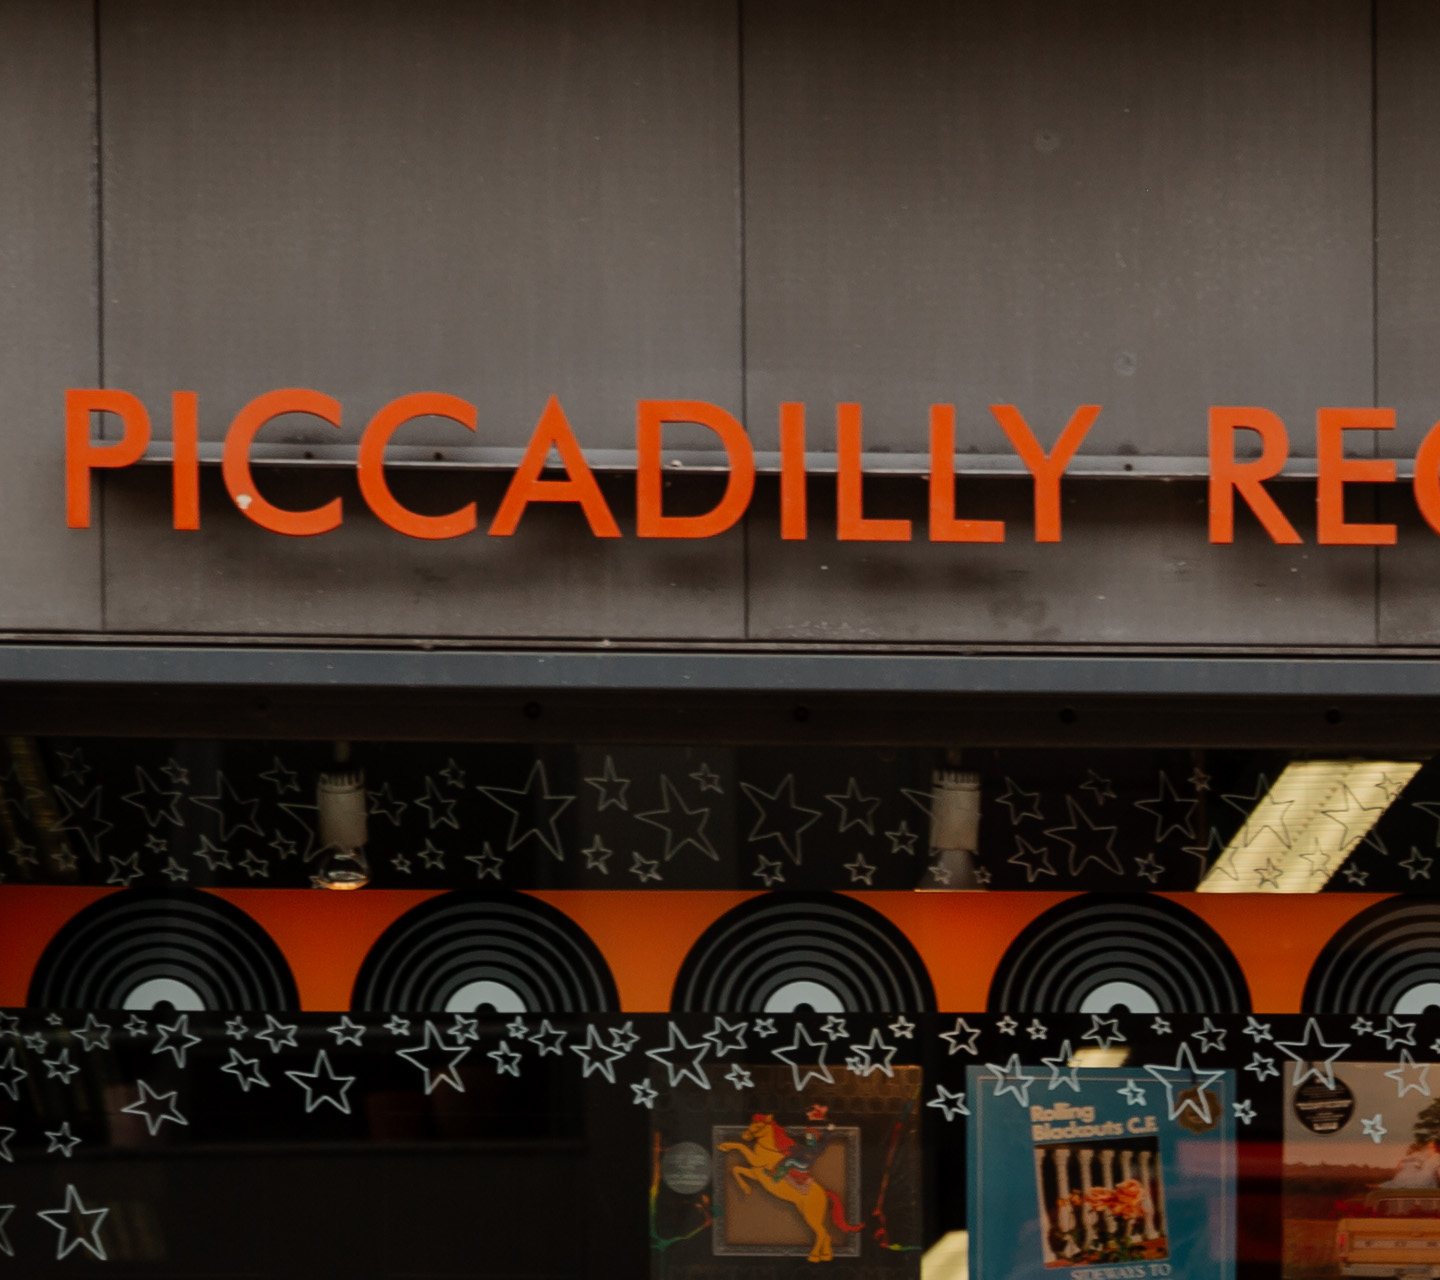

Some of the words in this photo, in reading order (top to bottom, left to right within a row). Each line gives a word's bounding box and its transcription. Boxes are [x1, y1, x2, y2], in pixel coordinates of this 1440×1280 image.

[65, 388, 1101, 543] PICCADILLY
[1030, 1102, 1095, 1122] Rolling
[1031, 1121, 1123, 1141] Blackouts
[1148, 1263, 1173, 1276] TO
